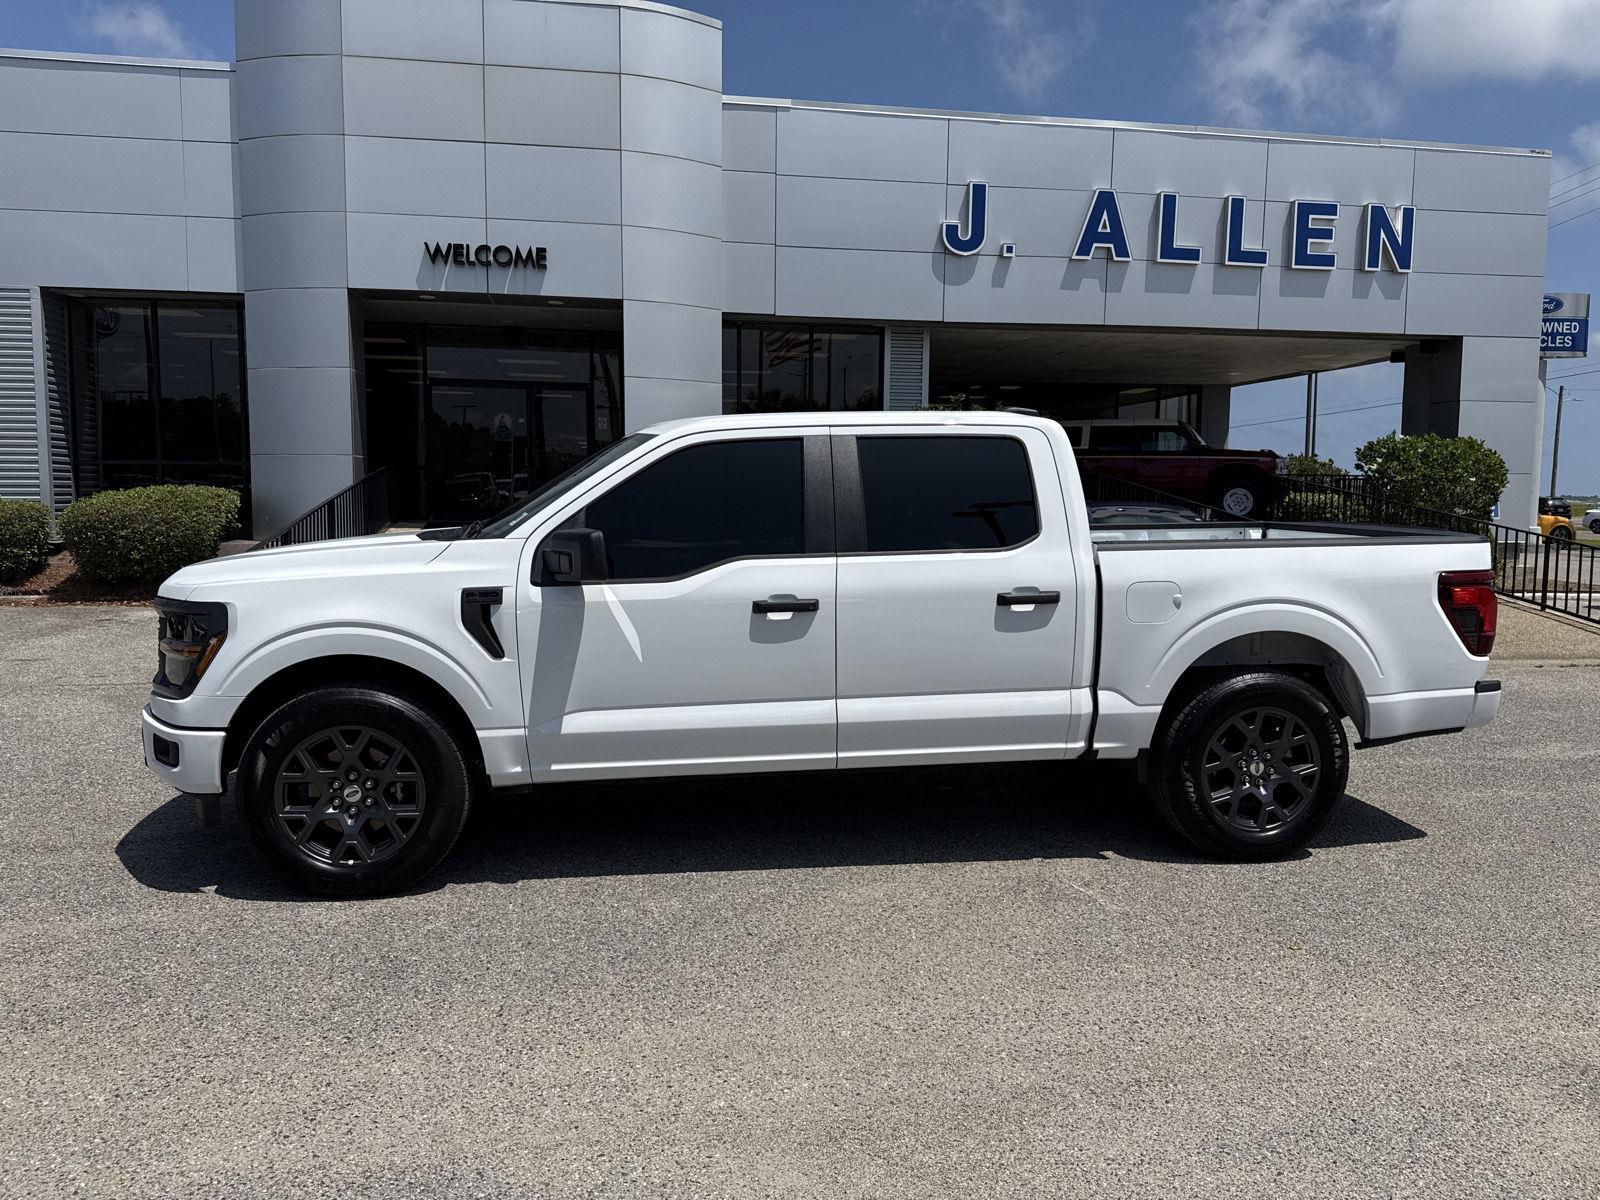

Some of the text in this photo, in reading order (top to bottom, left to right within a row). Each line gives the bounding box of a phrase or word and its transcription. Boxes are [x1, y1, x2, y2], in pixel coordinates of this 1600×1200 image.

[424, 241, 548, 270] WELCOME
[942, 180, 1416, 273] J. ALLEN
